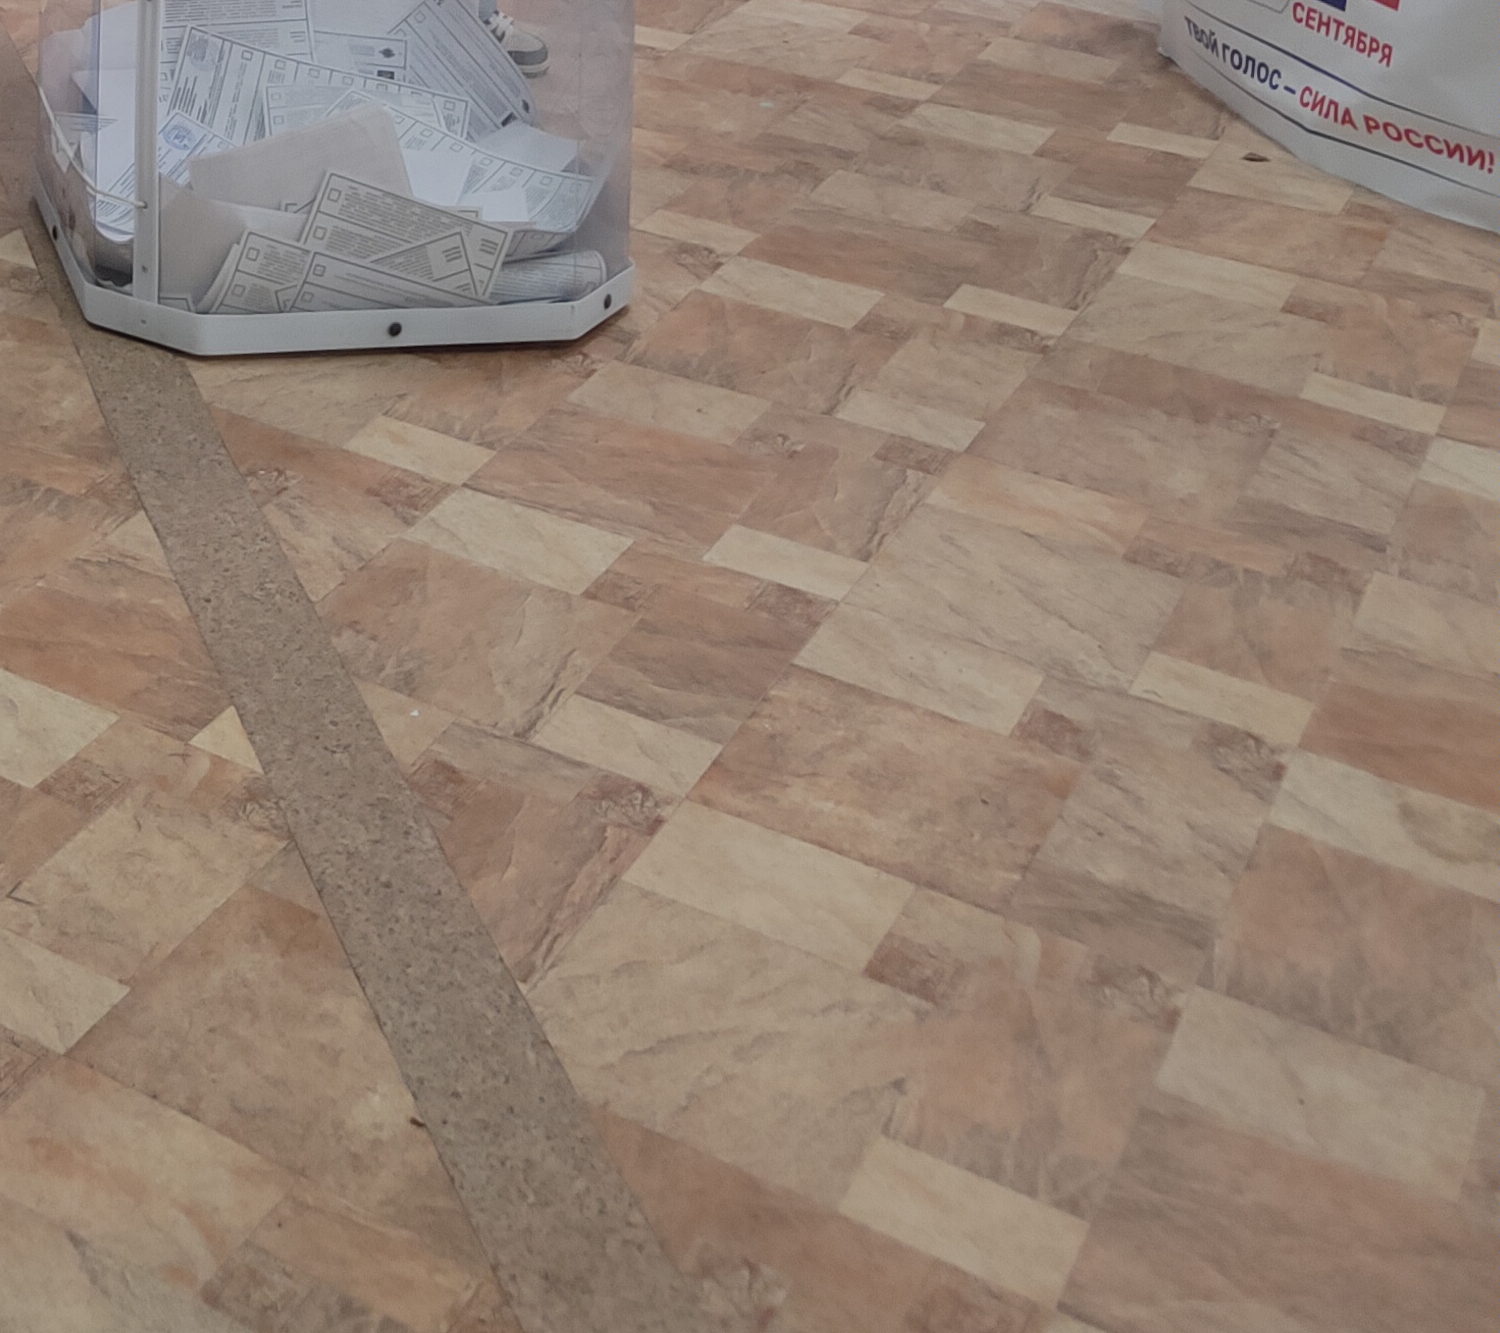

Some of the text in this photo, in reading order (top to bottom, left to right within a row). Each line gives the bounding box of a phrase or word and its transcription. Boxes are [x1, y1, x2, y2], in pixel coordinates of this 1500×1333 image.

[1292, 1, 1393, 68] СЕНТЯБРЯ
[1184, 15, 1495, 173] ТВОЙ ГОЛОС СИЛА РОССИИ!
